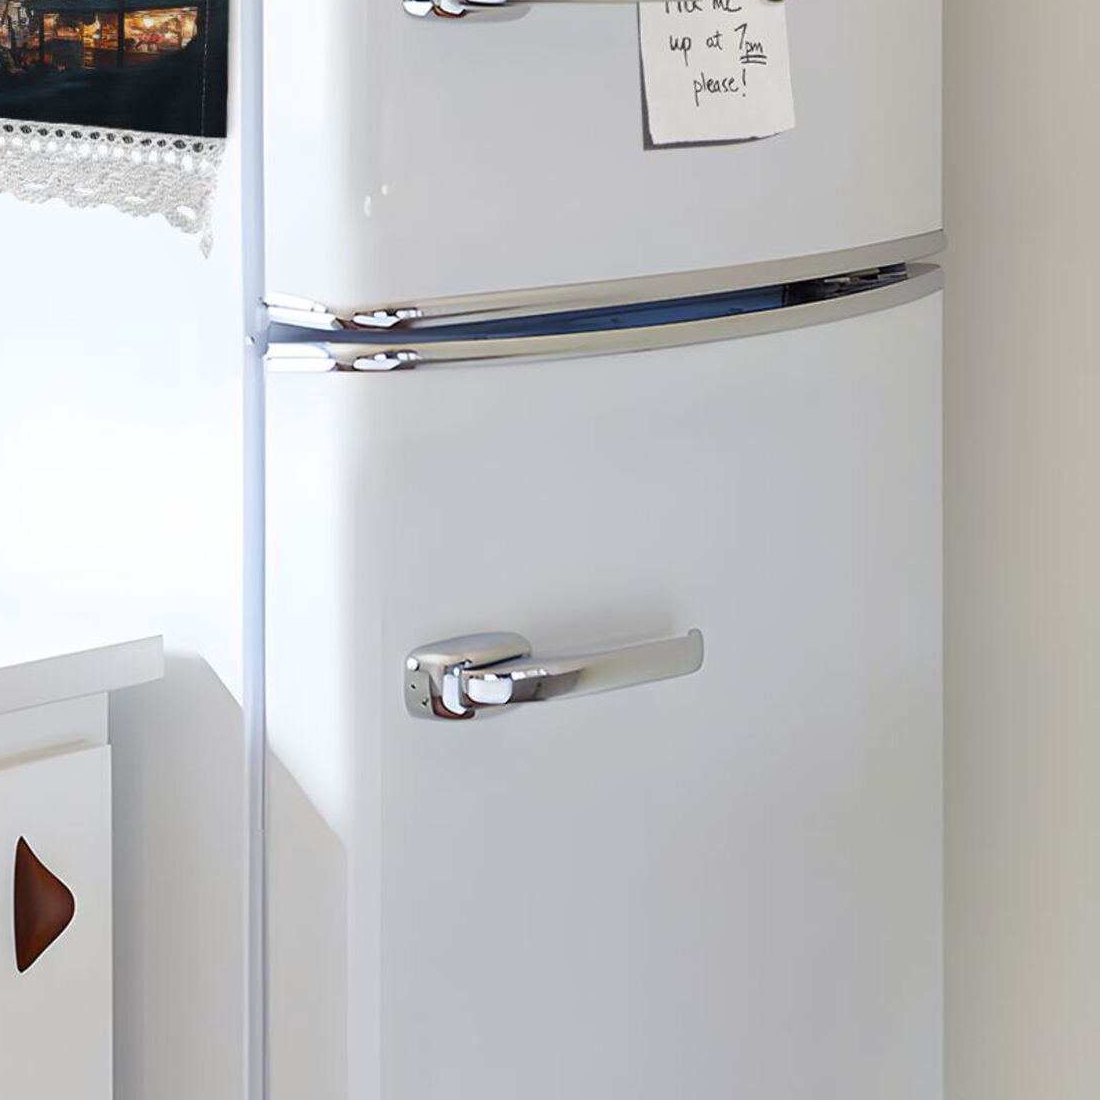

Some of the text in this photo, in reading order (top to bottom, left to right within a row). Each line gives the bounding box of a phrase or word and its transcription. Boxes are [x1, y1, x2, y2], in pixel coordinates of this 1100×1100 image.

[669, 35, 692, 66] up
[706, 30, 723, 50] at
[693, 68, 747, 107] please!
